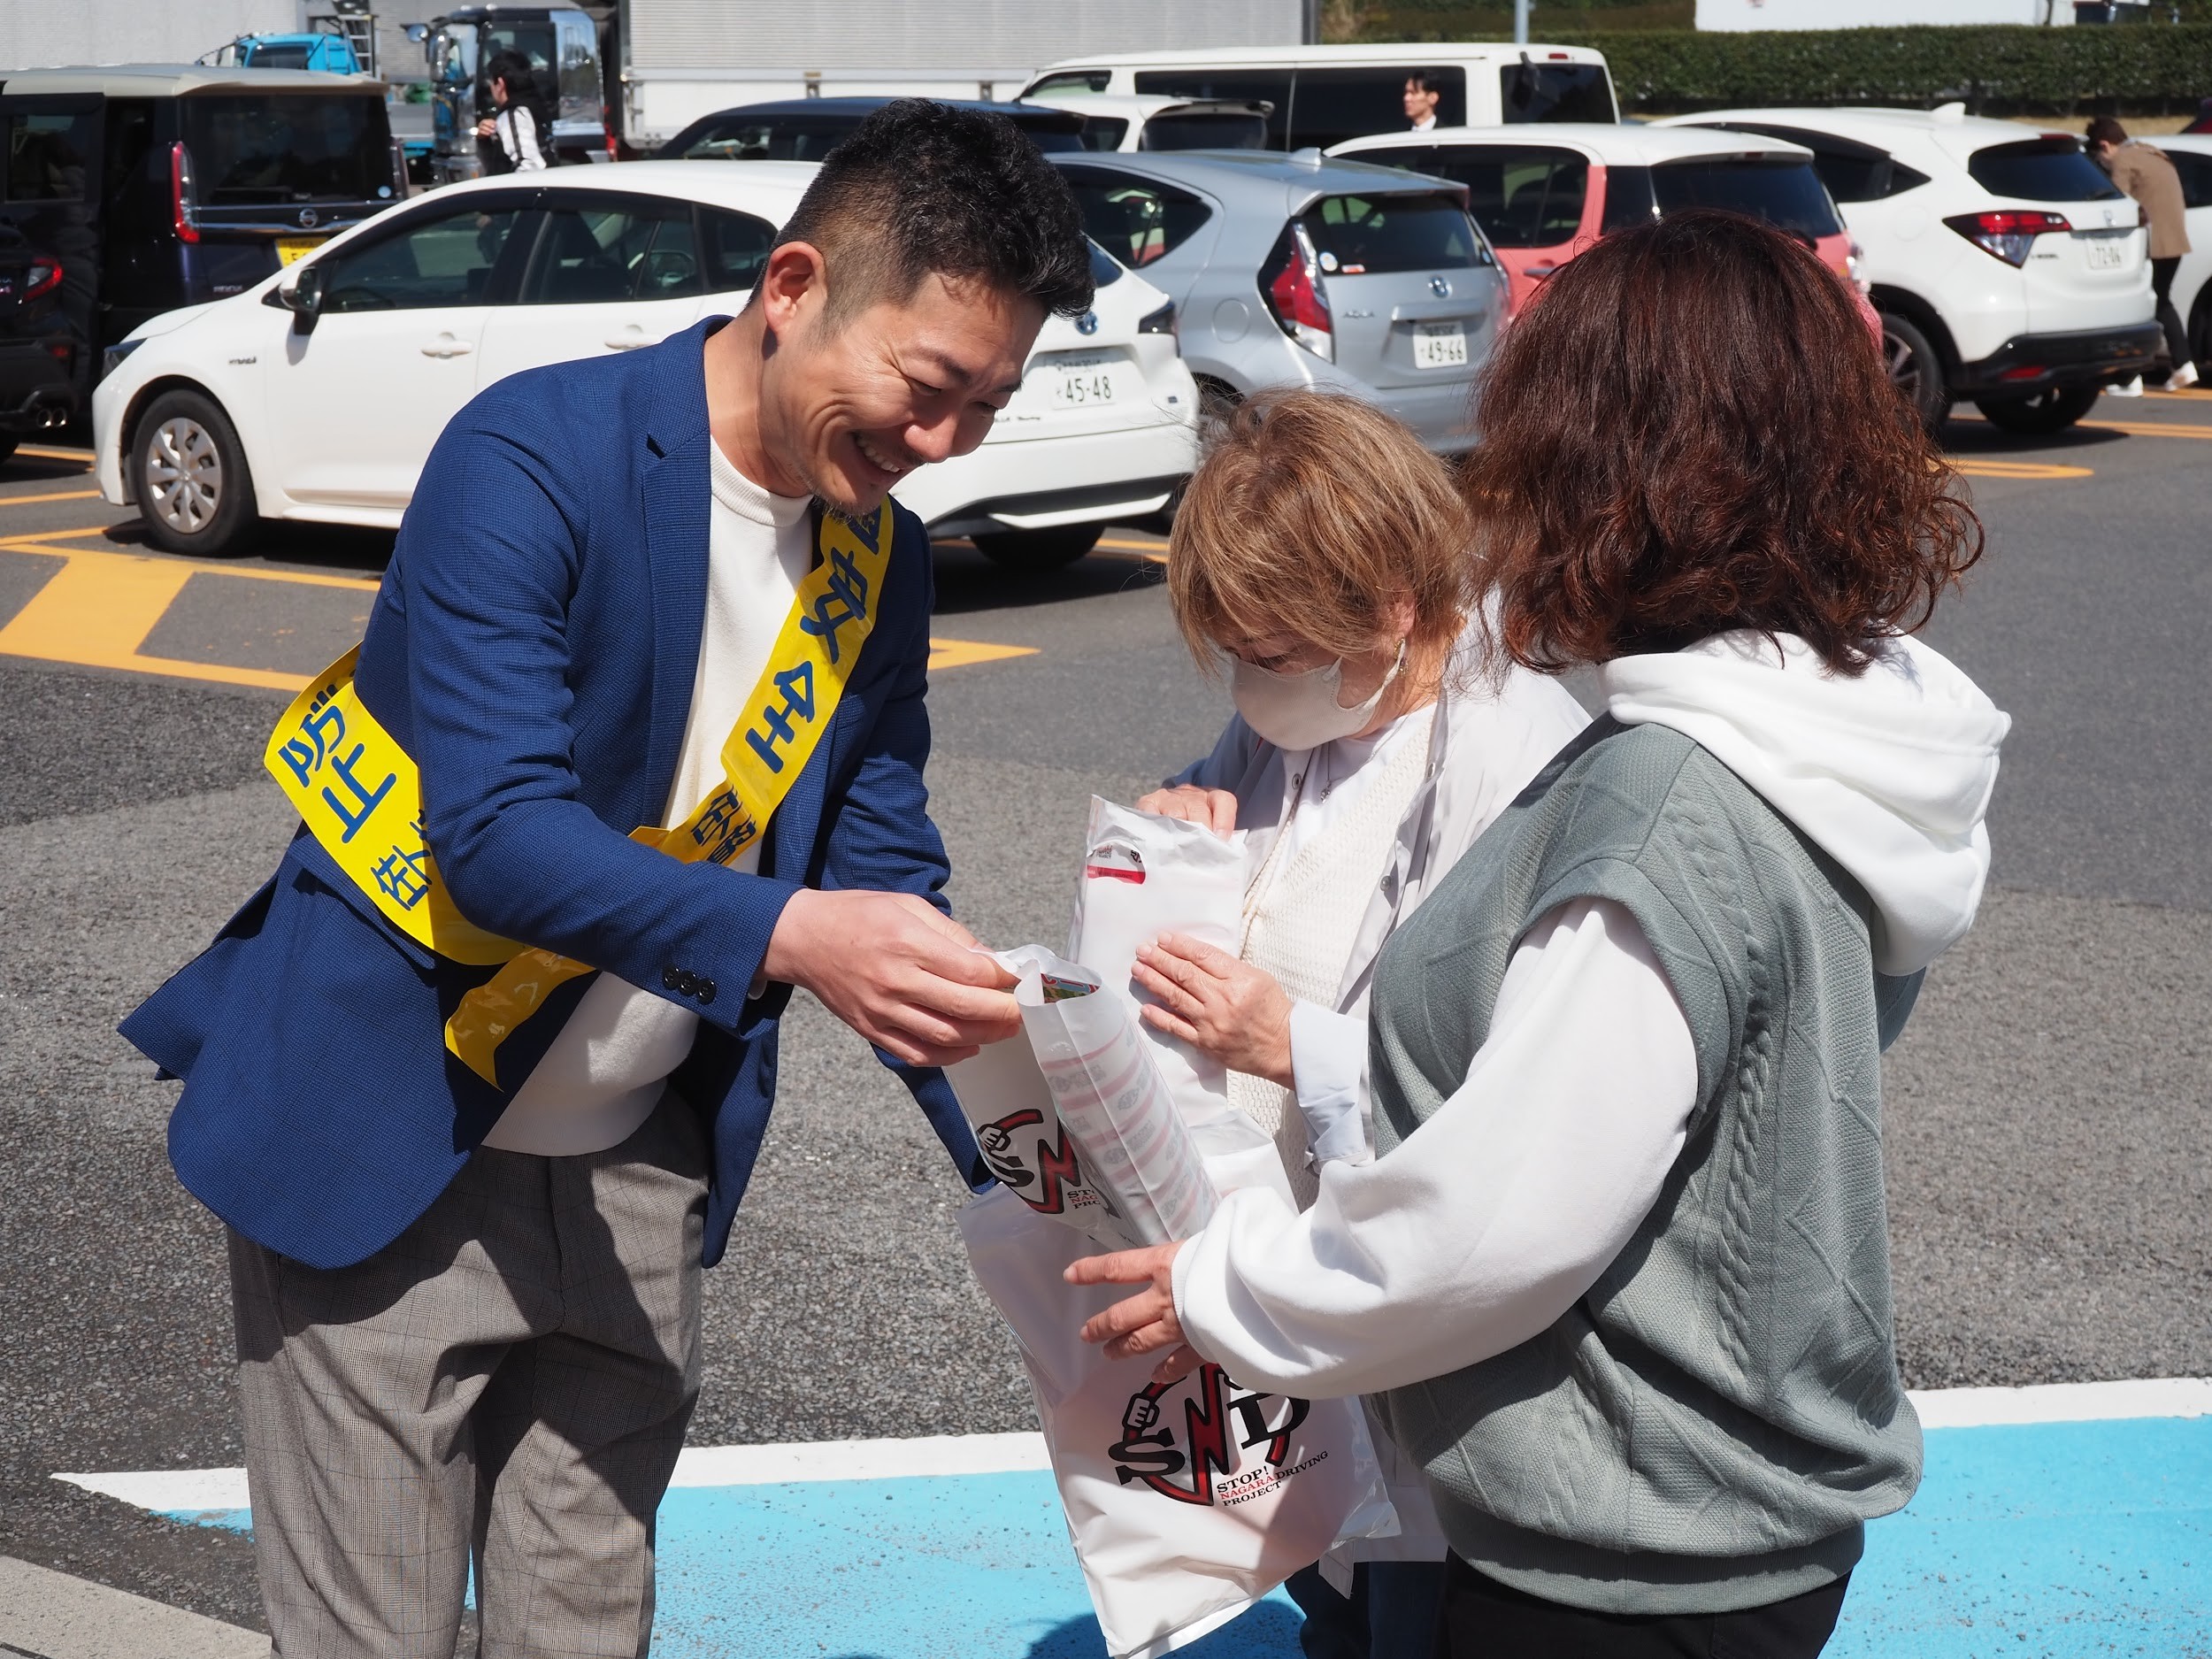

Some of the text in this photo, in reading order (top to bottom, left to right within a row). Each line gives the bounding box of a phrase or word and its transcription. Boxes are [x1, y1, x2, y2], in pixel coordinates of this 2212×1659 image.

[1427, 341, 1463, 363] 49-66
[1065, 375, 1112, 403] 45-48
[1067, 1189, 1095, 1199] ST
[1217, 1465, 1270, 1494] STOP!
[1219, 1450, 1329, 1500] NAGARA DRIVING
[1222, 1480, 1282, 1507] PROJECT
